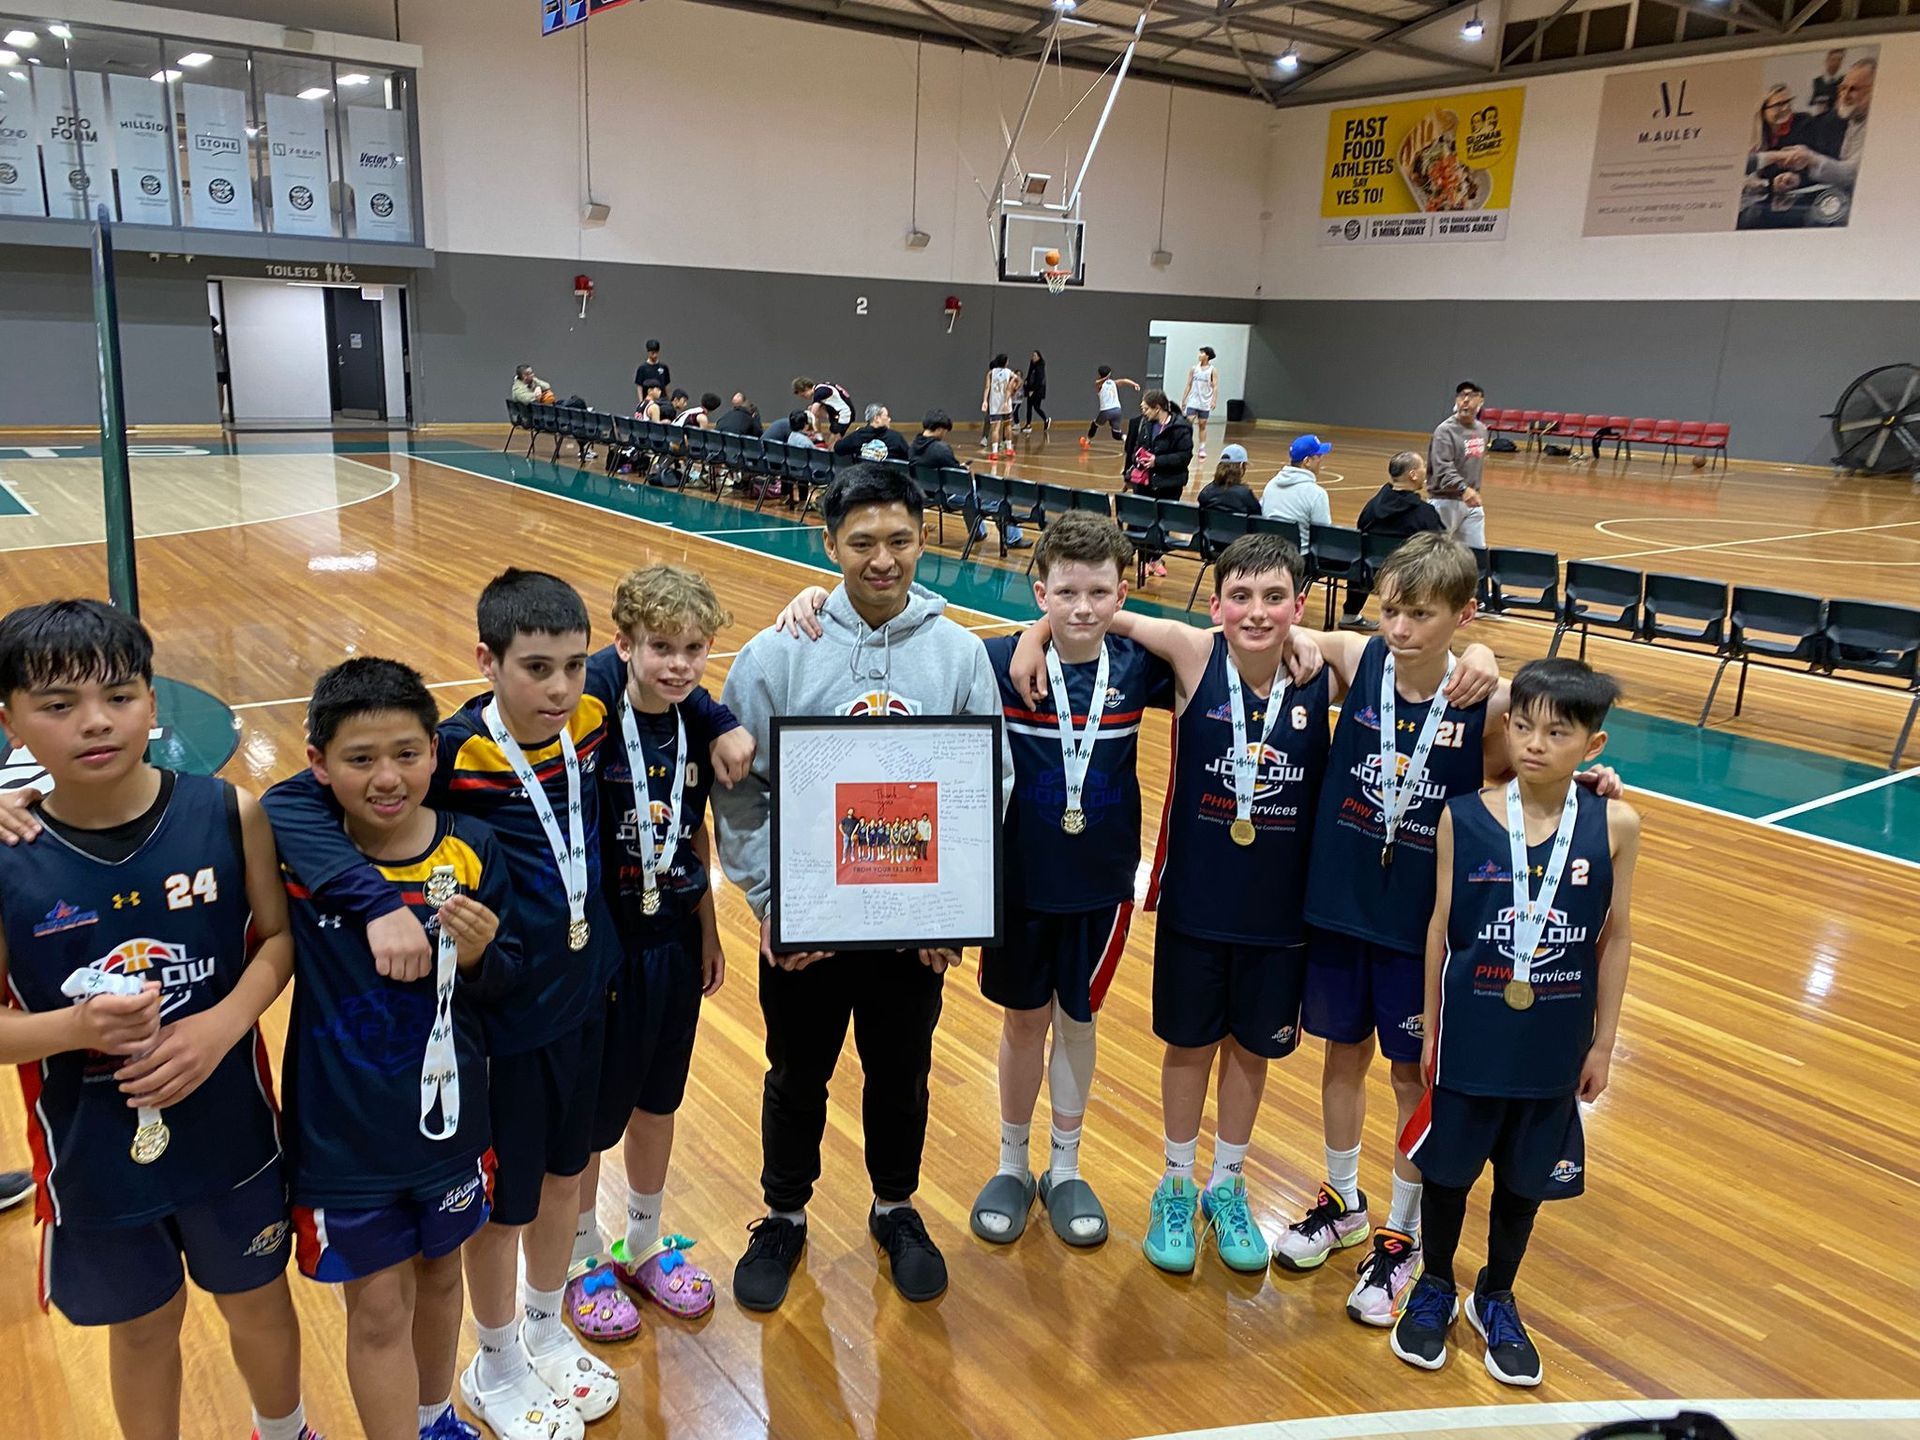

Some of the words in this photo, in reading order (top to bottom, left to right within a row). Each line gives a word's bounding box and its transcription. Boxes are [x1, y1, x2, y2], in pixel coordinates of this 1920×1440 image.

[1344, 116, 1388, 140] FAST
[199, 137, 237, 151] STONE
[1343, 139, 1385, 161] FOOD
[1331, 159, 1394, 178] ATHLETES
[1352, 177, 1368, 188] SAY
[1336, 189, 1359, 205] YES
[1362, 187, 1384, 204] TO!
[1379, 227, 1401, 237] MINS
[1402, 225, 1426, 236] AWAY
[1439, 225, 1448, 234] 10
[1450, 224, 1471, 233] MINS
[1472, 223, 1495, 232] AWAY
[266, 264, 319, 278] TOILETS
[856, 297, 868, 315] 2
[1291, 705, 1307, 730] 6
[1434, 721, 1466, 748] 21
[1201, 793, 1237, 810] PHW
[1250, 803, 1298, 816] ervices
[1342, 797, 1373, 818] PHW
[1374, 811, 1436, 837] Svices
[1571, 858, 1590, 886] 2
[165, 867, 218, 911] 24
[1530, 969, 1582, 983] ervices
